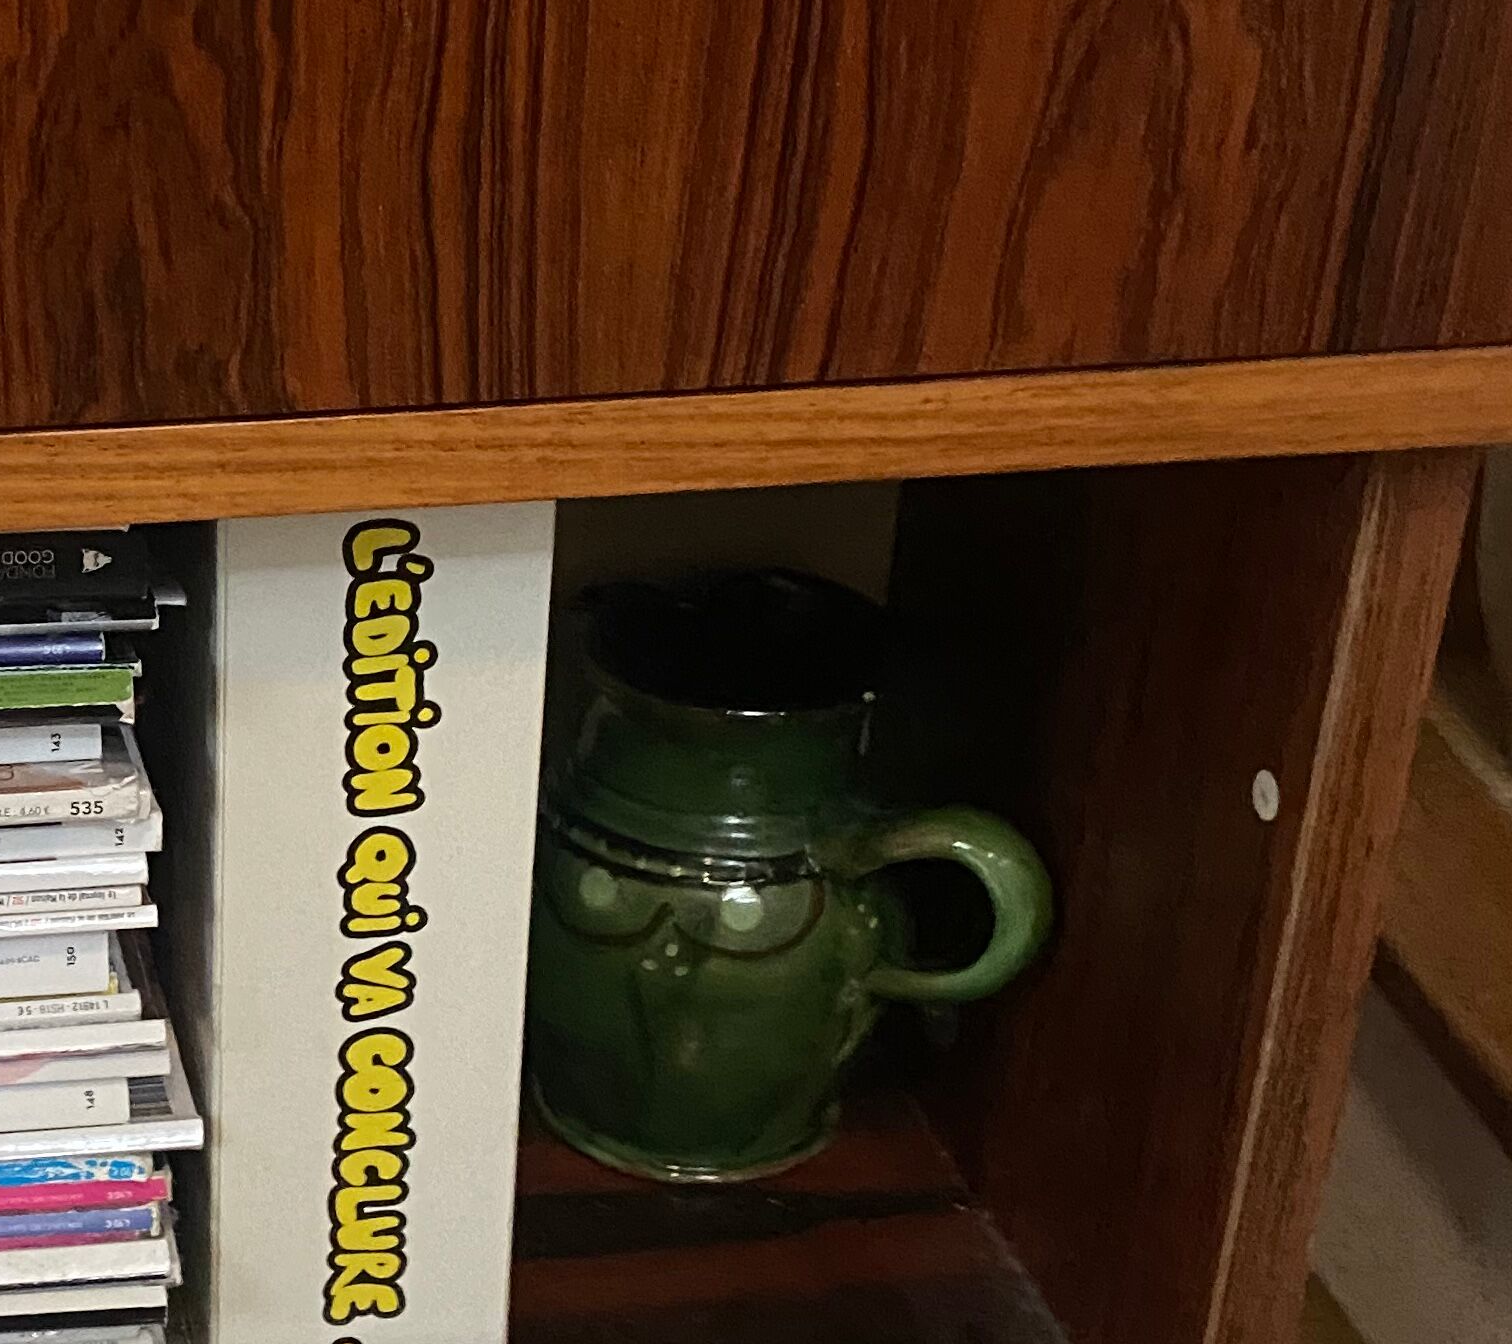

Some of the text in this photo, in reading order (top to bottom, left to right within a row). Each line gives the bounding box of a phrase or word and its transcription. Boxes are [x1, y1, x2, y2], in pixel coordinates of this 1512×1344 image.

[50, 732, 62, 753] 143
[70, 800, 104, 817] 535
[114, 827, 125, 847] 142
[334, 940, 417, 1023] VA
[322, 1026, 417, 1326] CONCLURE
